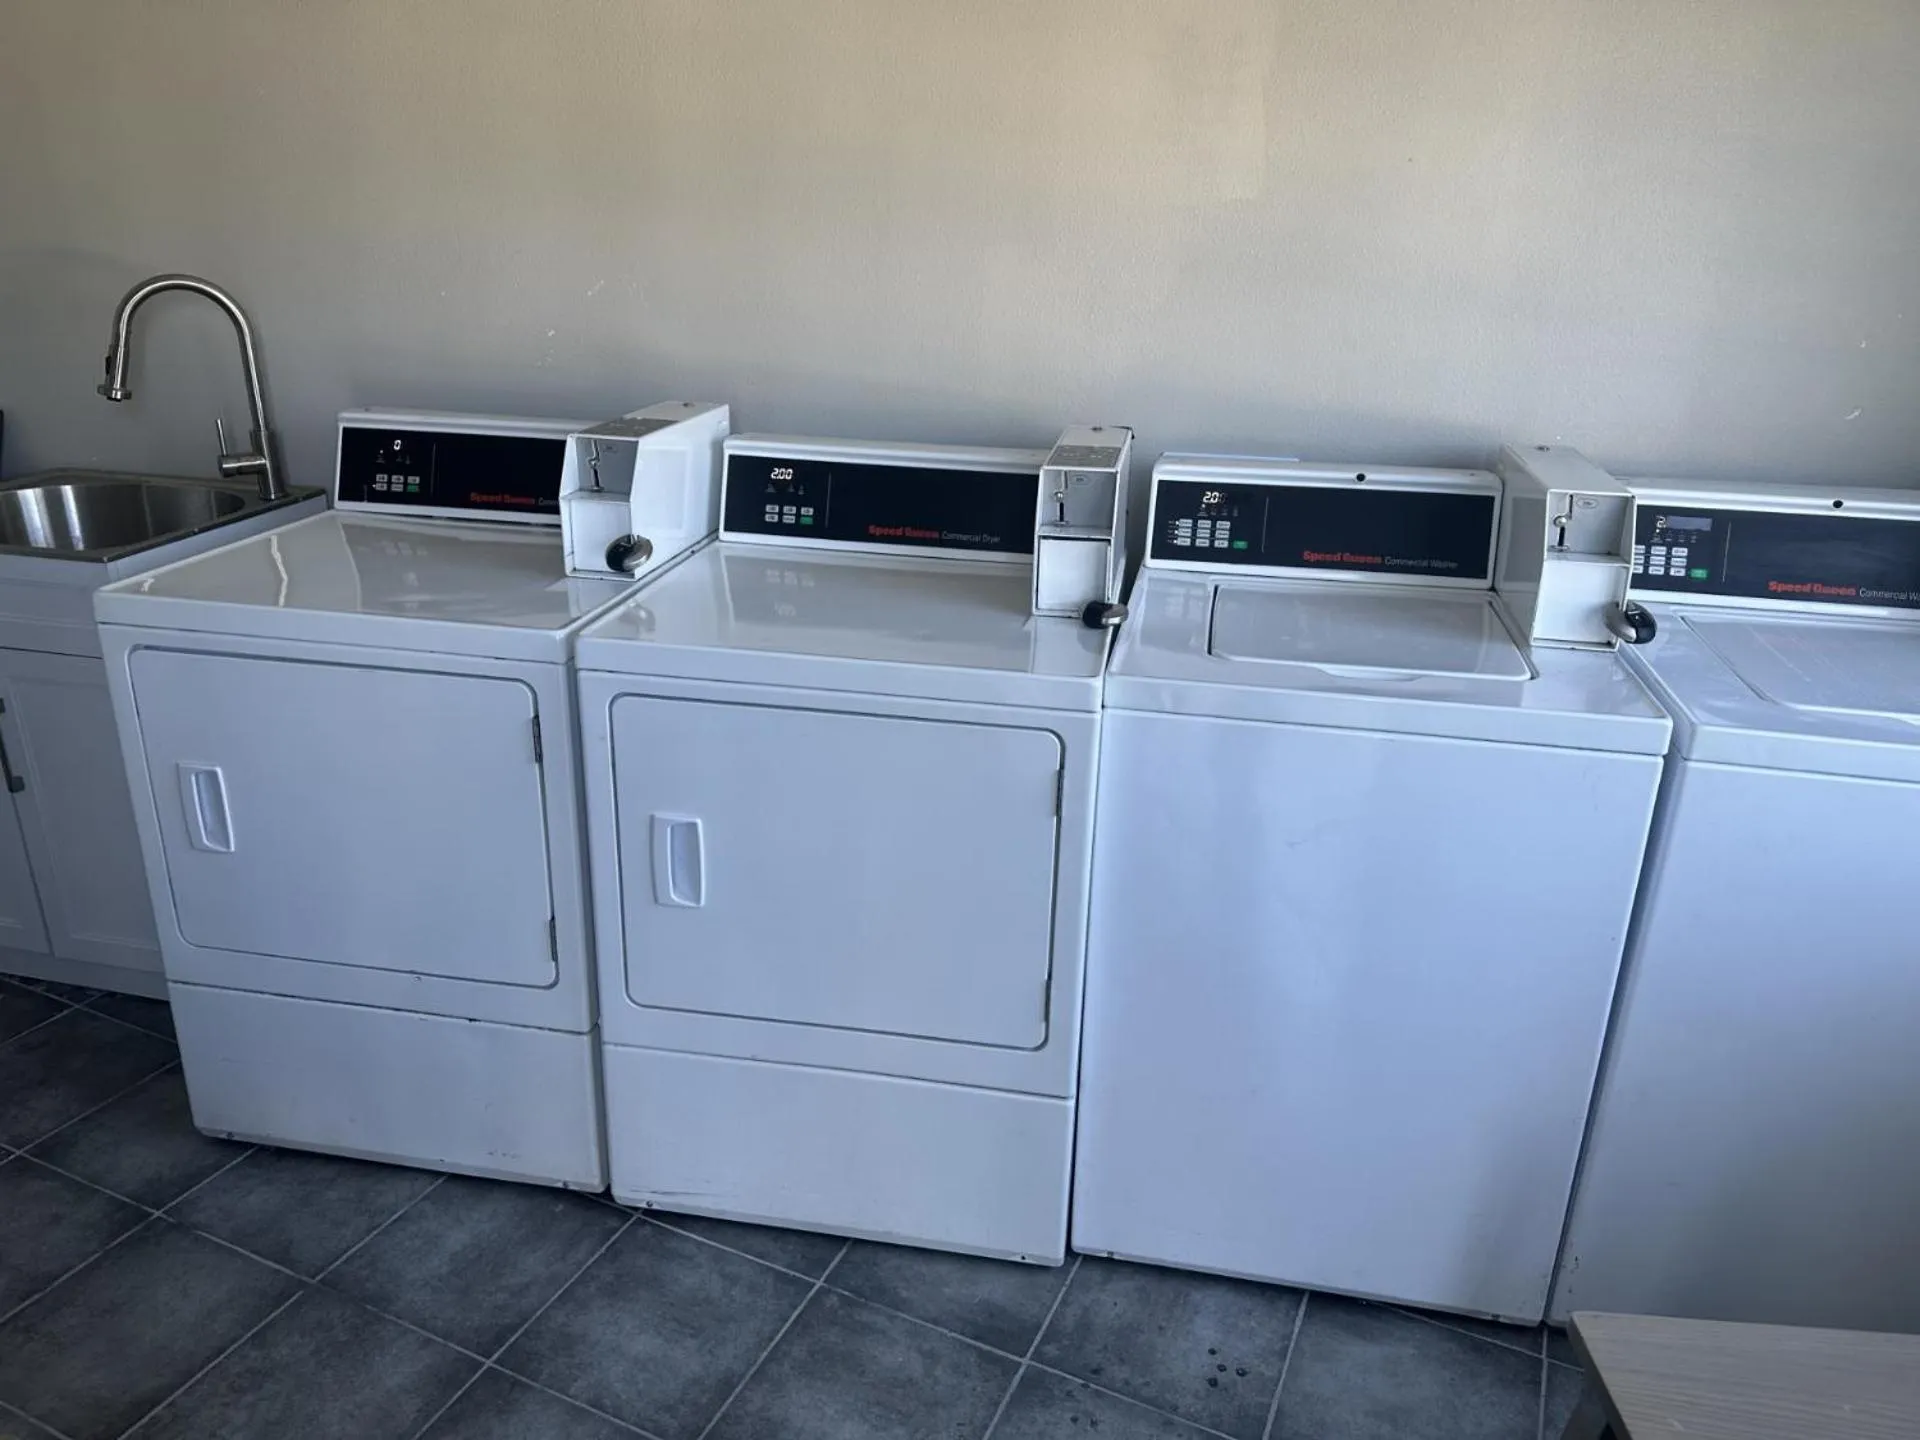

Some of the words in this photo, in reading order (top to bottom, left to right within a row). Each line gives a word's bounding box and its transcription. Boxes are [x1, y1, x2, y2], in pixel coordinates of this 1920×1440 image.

[868, 525, 903, 536] Speed
[904, 526, 940, 538] Queen
[942, 531, 981, 542] Commercial
[982, 533, 1001, 544] Dryer
[1303, 551, 1342, 562] Speed
[1342, 553, 1382, 564] Queen
[1384, 556, 1429, 567] Commercial
[1430, 559, 1459, 569] Washer
[1768, 580, 1812, 593] Speed
[1812, 582, 1857, 596] Queen
[1859, 587, 1908, 600] Commercial
